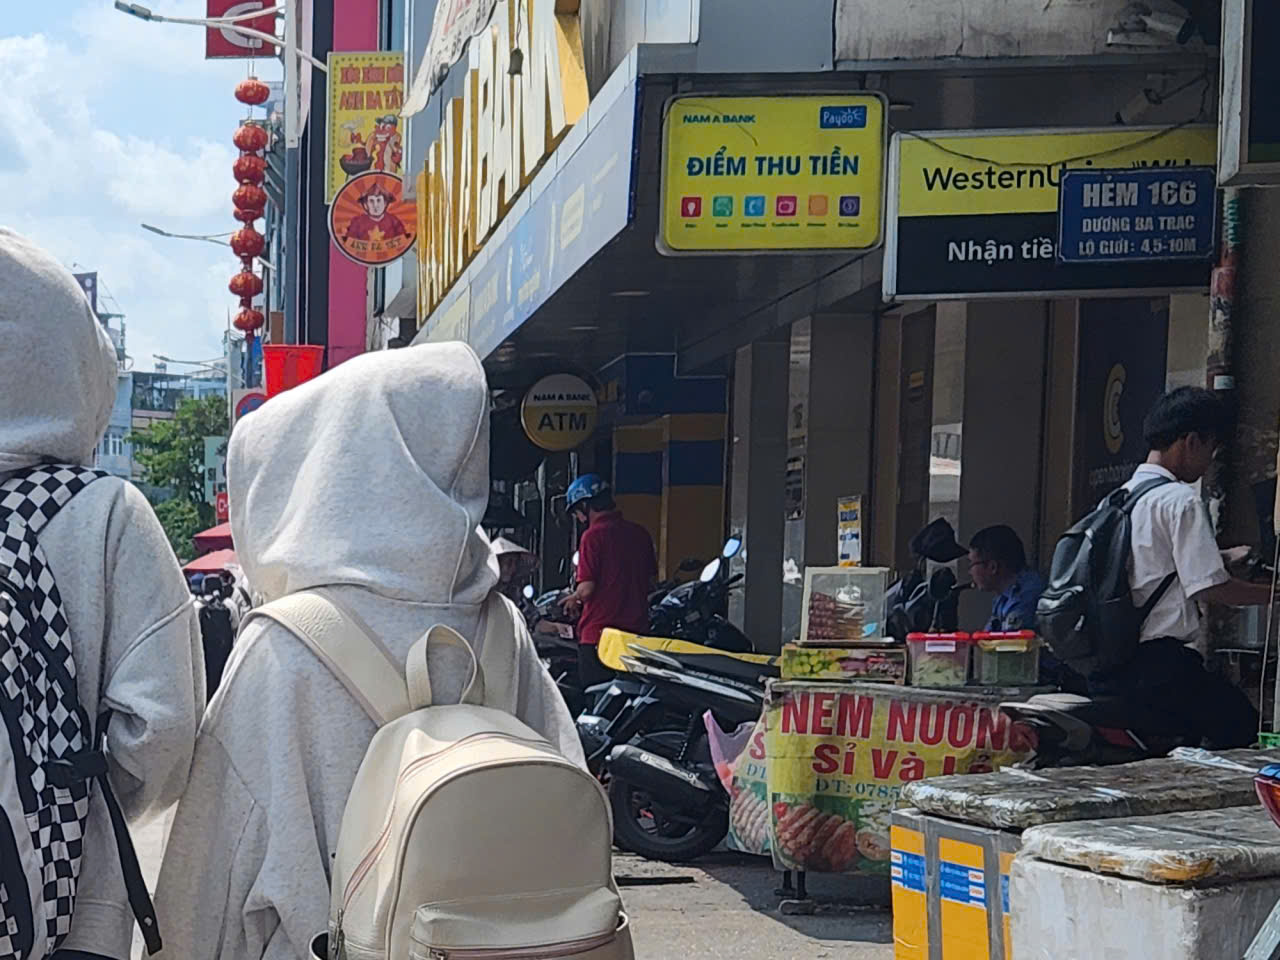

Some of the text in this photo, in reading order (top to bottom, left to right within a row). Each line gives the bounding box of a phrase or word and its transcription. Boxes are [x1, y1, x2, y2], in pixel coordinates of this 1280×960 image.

[683, 114, 757, 124] NAM A BANK
[823, 111, 854, 127] Payoo
[687, 146, 860, 176] ĐIỂM THU TIỀN
[923, 160, 1067, 191] WesternU
[1147, 181, 1196, 206] 166
[948, 237, 1058, 264] Nhận tiề
[538, 412, 587, 431] ATM
[781, 692, 874, 739] NEM
[871, 747, 925, 782] Và
